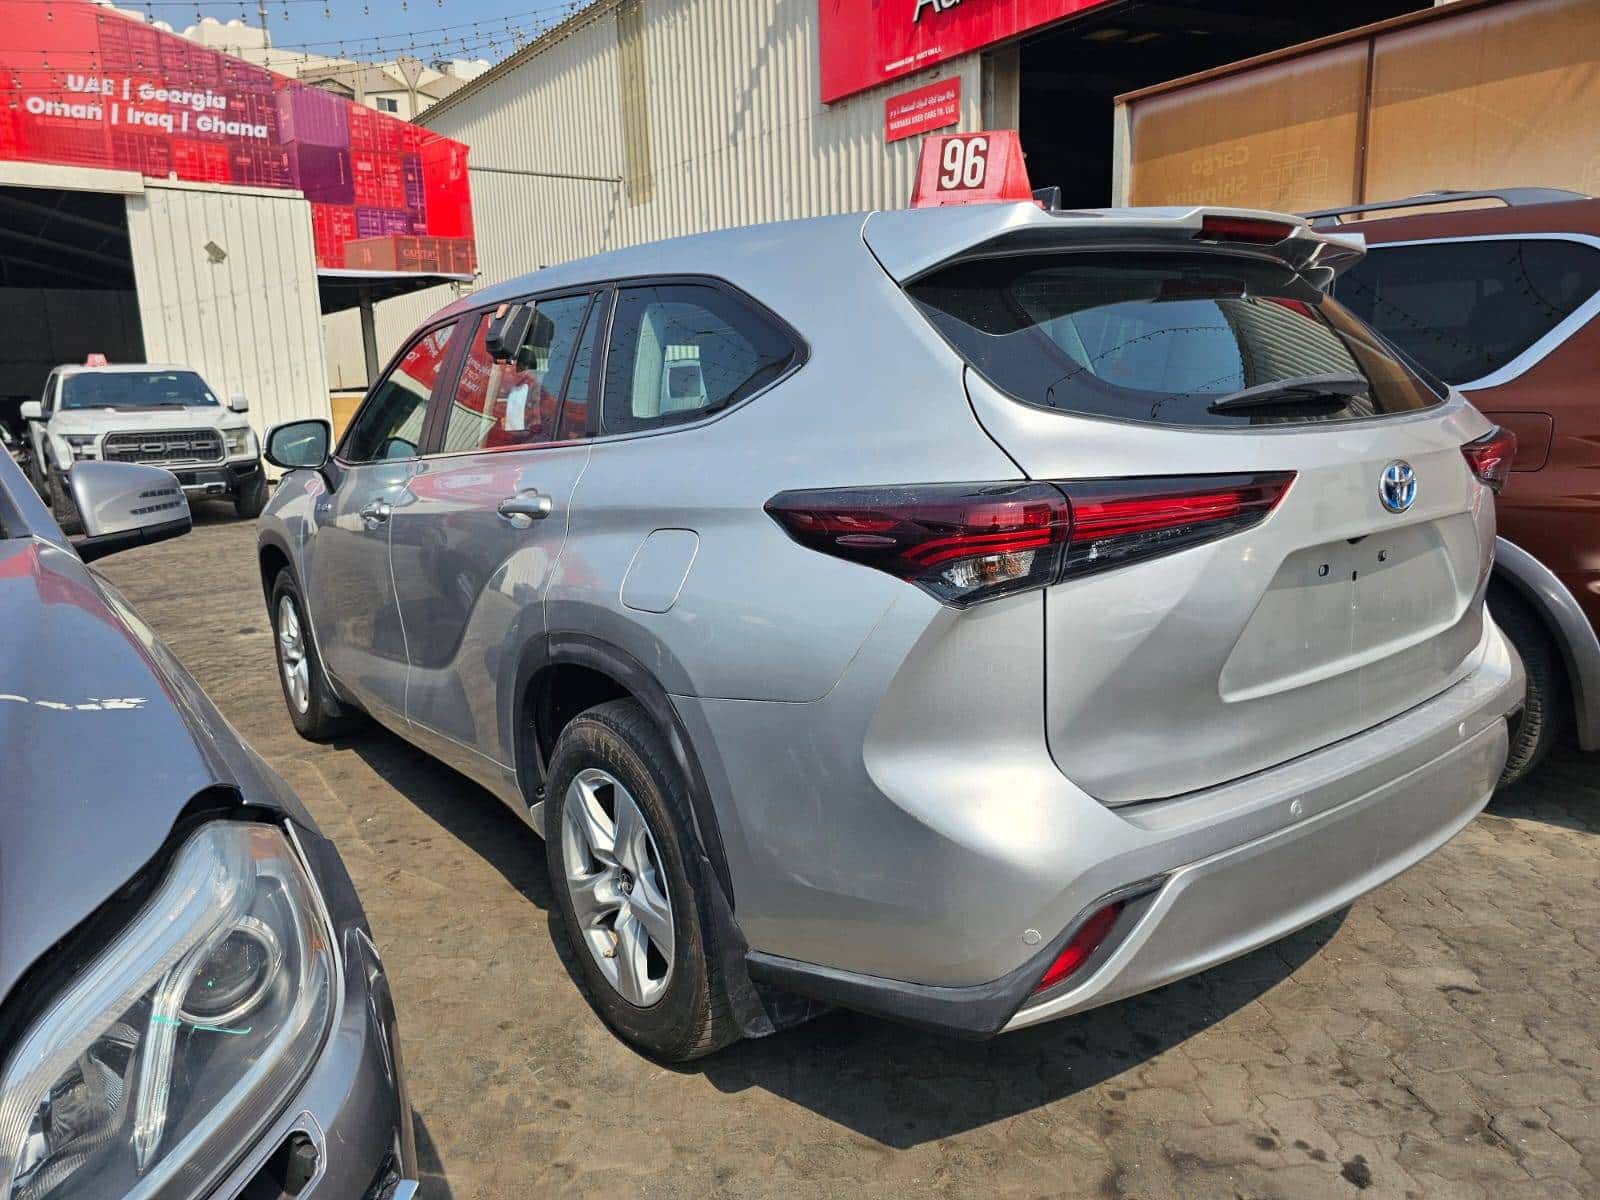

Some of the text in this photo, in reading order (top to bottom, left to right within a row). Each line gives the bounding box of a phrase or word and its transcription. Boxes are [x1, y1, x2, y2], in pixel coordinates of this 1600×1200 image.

[67, 74, 114, 96] UAE
[138, 83, 227, 112] Georgia
[946, 104, 955, 114] LLC
[26, 97, 103, 121] Oman
[127, 107, 174, 133] Iraq
[196, 115, 268, 138] Ghana
[941, 137, 988, 189] 96
[105, 440, 217, 455] FORD
